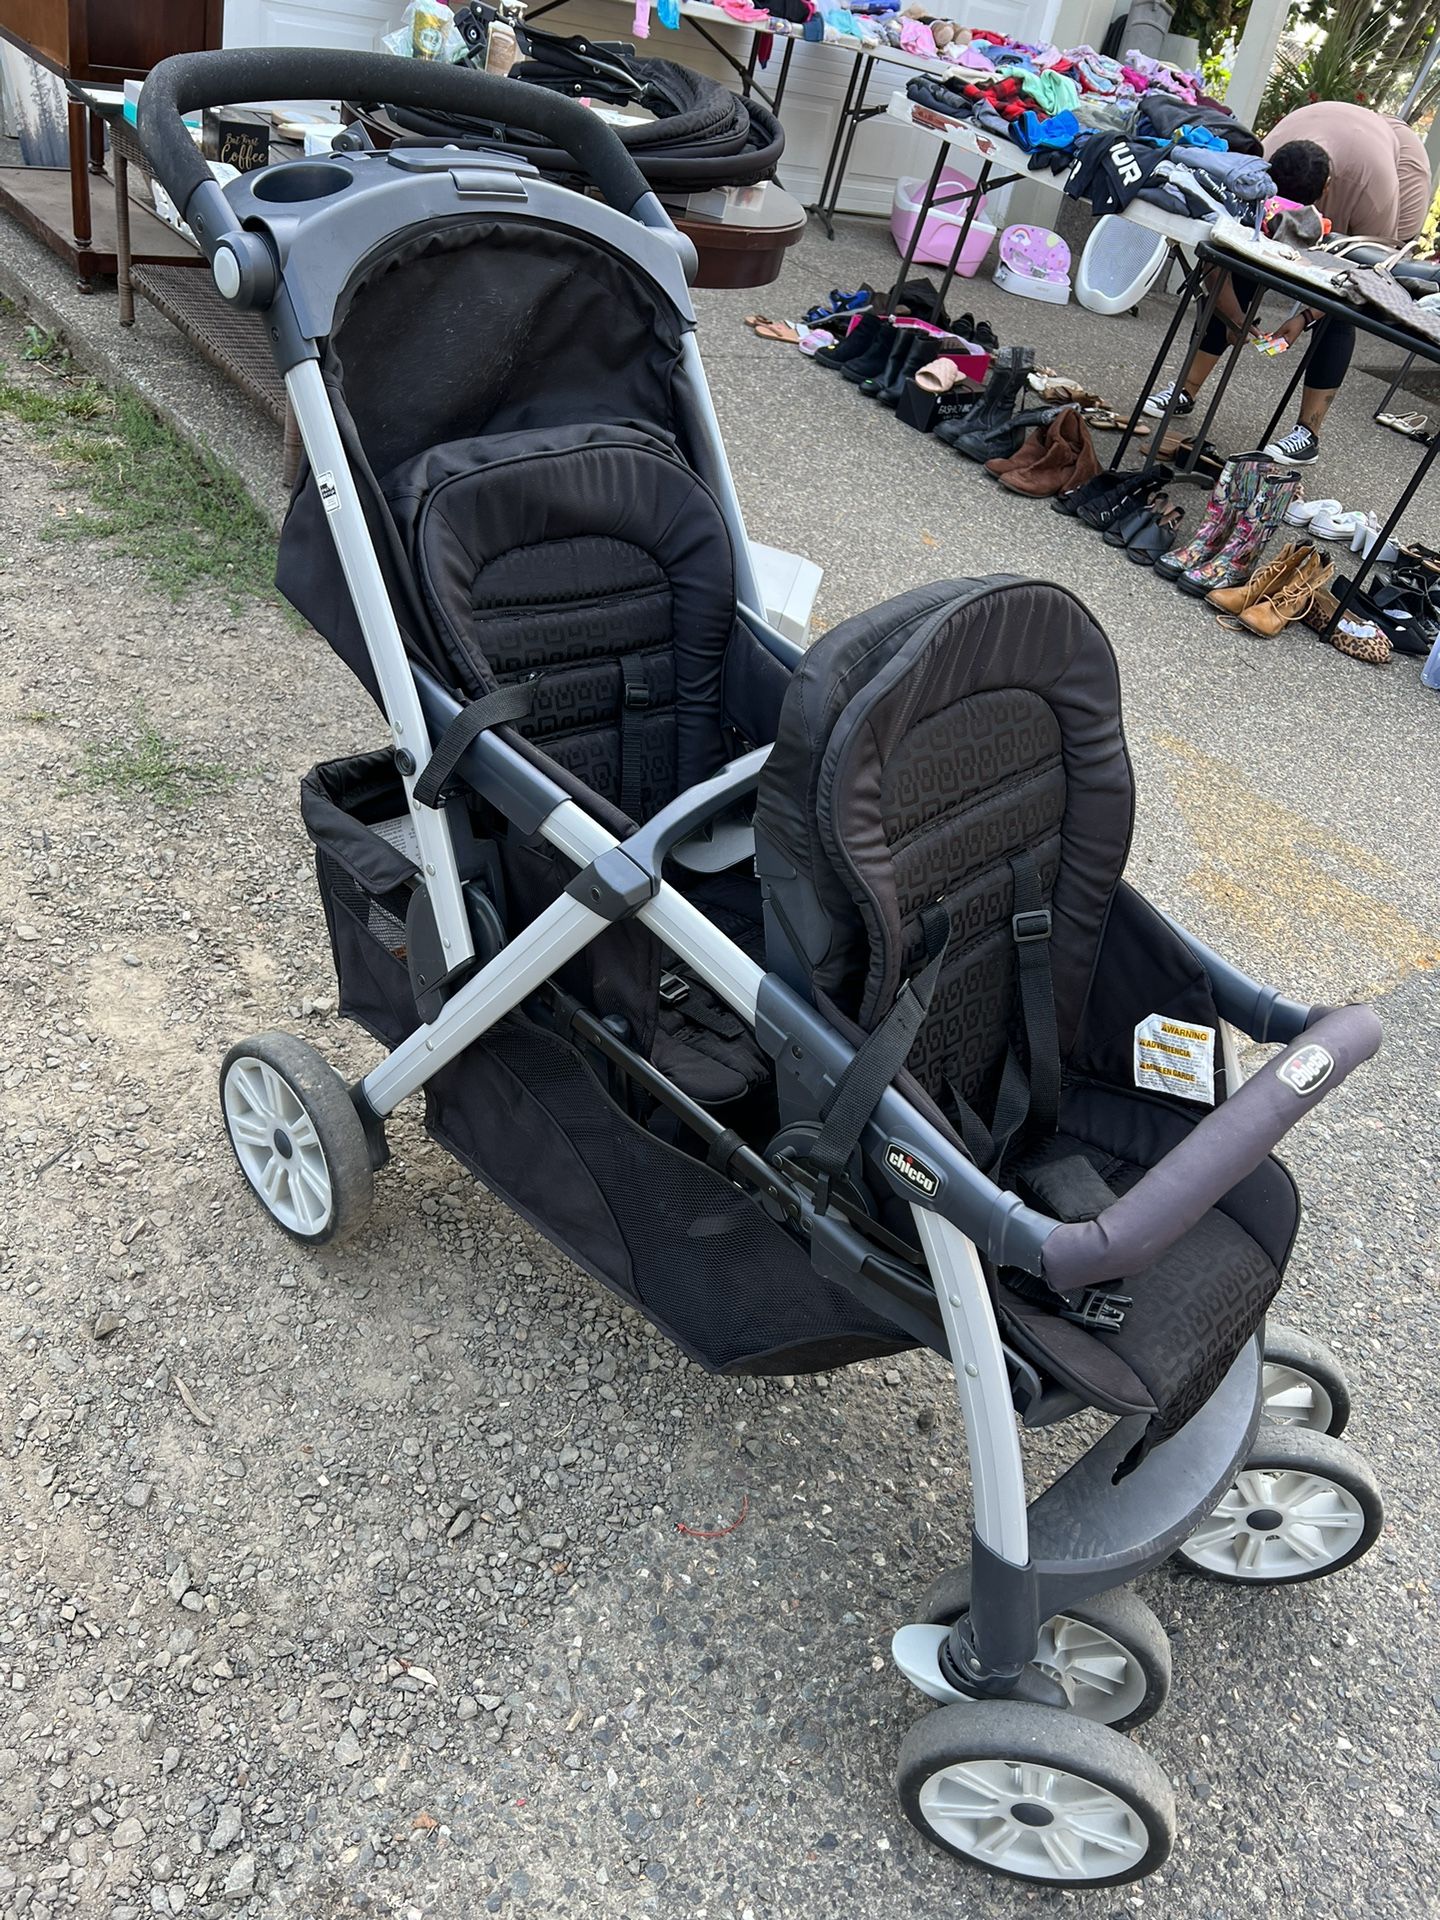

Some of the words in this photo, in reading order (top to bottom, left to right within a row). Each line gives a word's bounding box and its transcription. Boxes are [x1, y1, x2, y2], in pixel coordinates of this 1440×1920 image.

[221, 143, 267, 170] Coffee
[1166, 1025, 1208, 1041] WARNING
[1290, 1049, 1330, 1088] chicco
[889, 1152, 933, 1191] chicco
